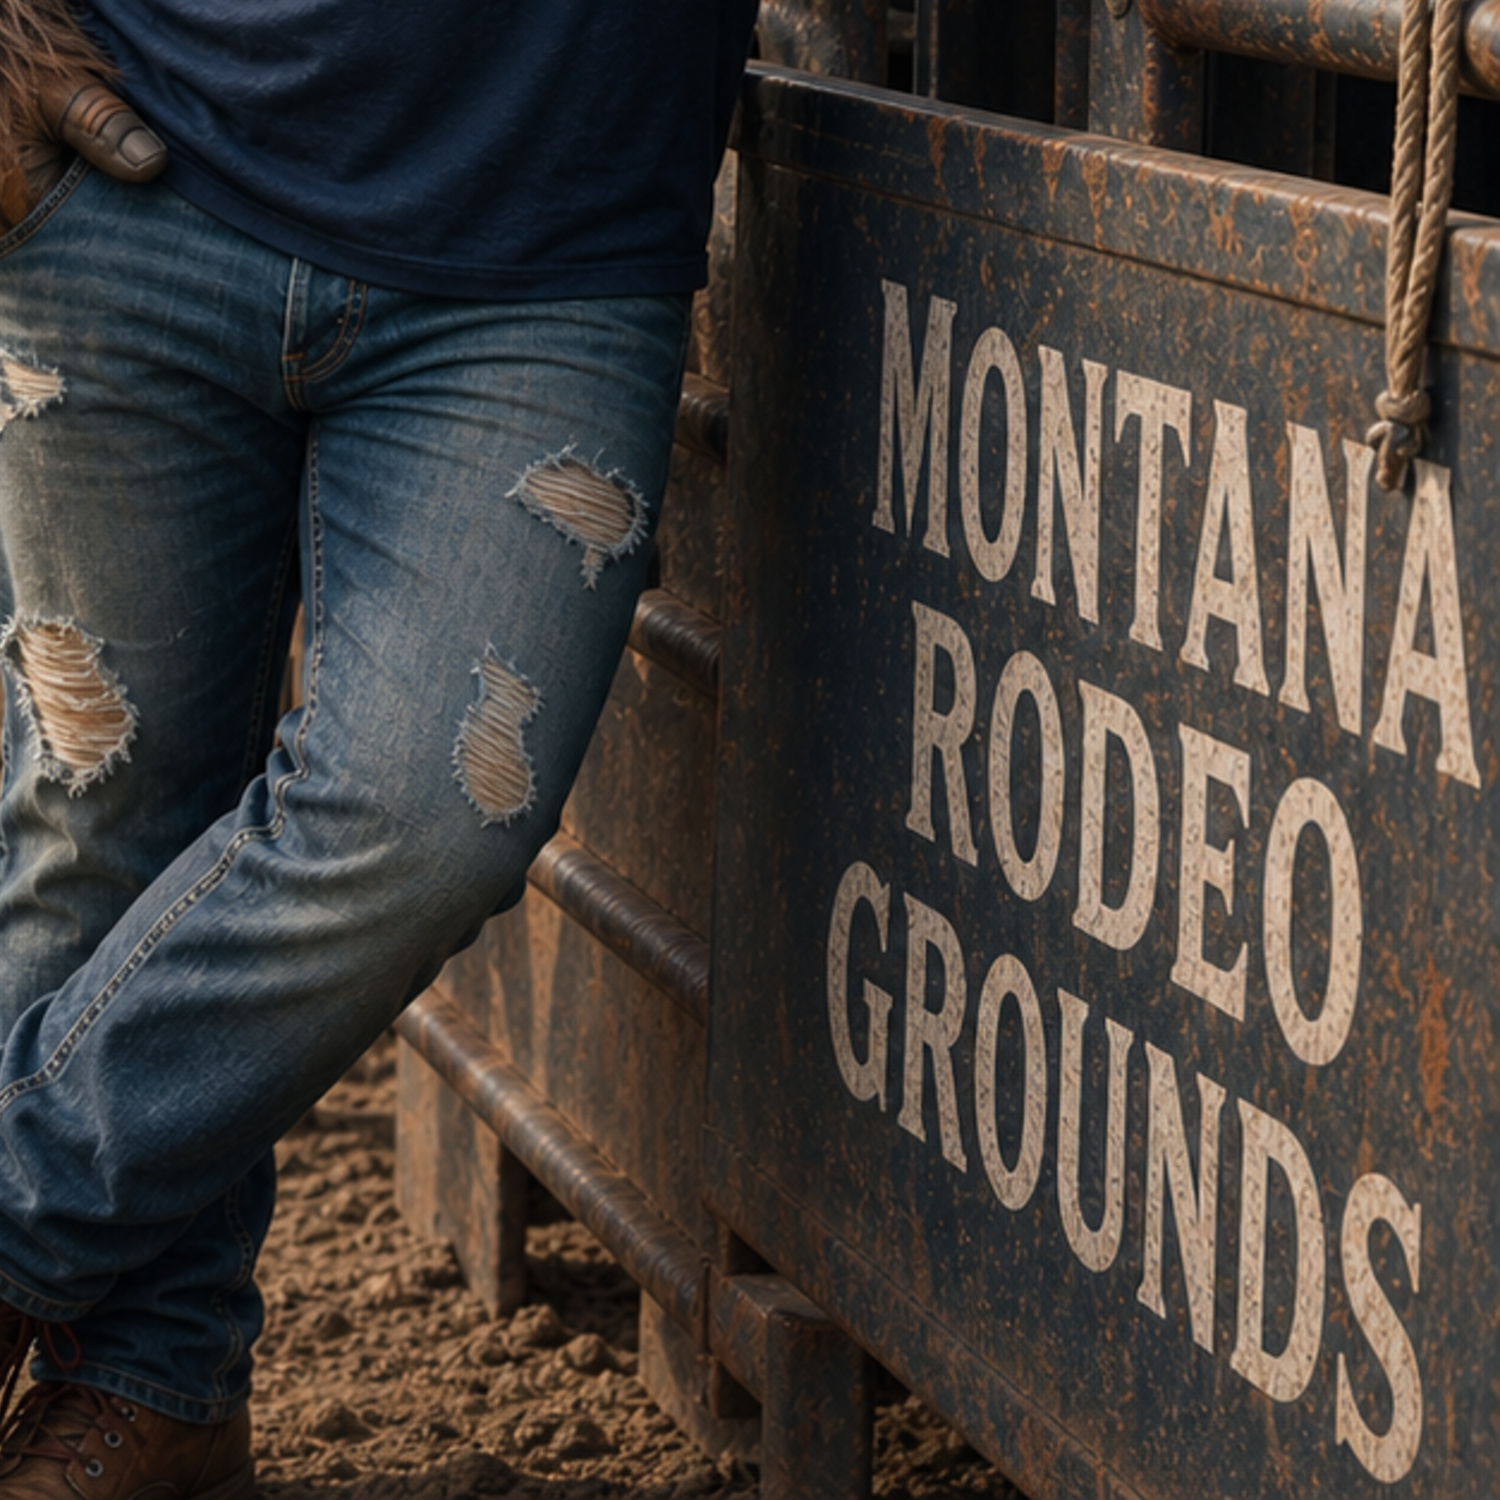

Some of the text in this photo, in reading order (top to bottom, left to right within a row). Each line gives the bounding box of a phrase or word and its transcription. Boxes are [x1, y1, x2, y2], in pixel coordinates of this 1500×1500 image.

[871, 278, 1482, 789] MONTANA
[904, 599, 1363, 1068] RODEO
[826, 860, 1423, 1484] GROUNDS
